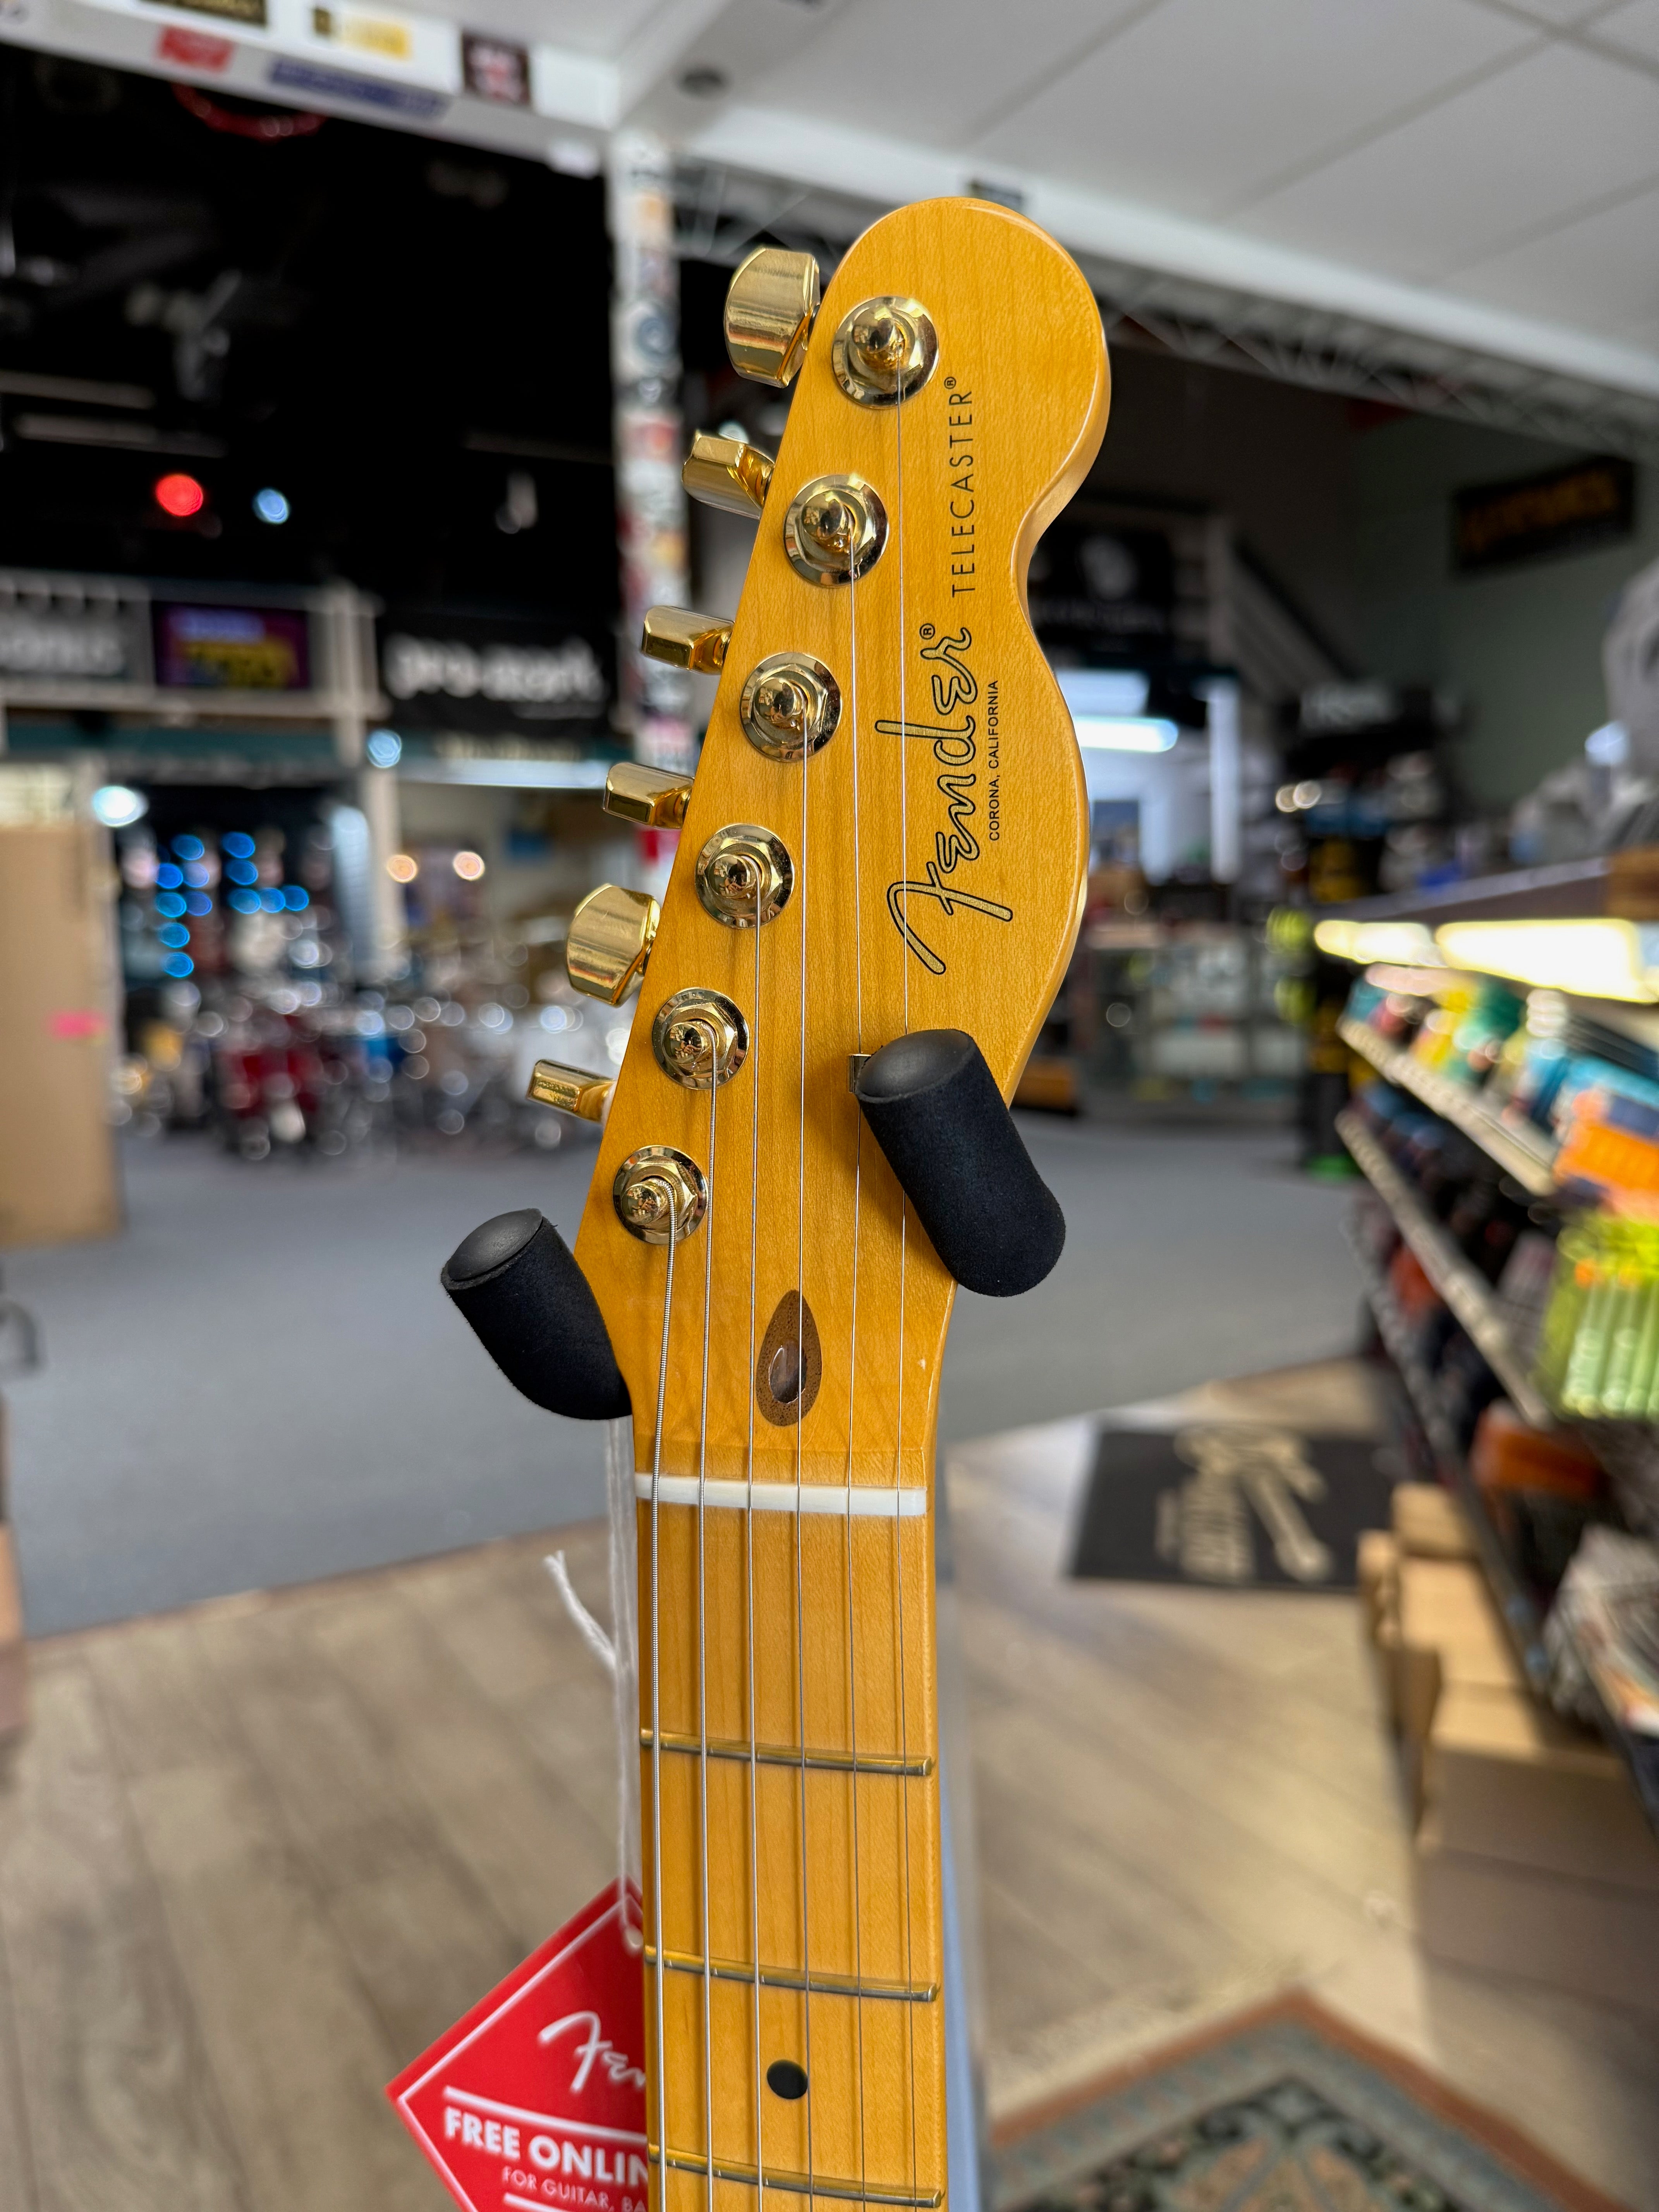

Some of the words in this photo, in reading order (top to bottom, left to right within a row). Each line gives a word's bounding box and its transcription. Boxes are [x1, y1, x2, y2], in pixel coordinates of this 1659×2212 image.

[988, 680, 999, 769] CALIFORNIA
[989, 775, 1001, 841] CORONA,
[444, 2106, 521, 2161] FREE
[528, 2134, 649, 2188] ONLIN
[503, 2166, 538, 2191] FOR
